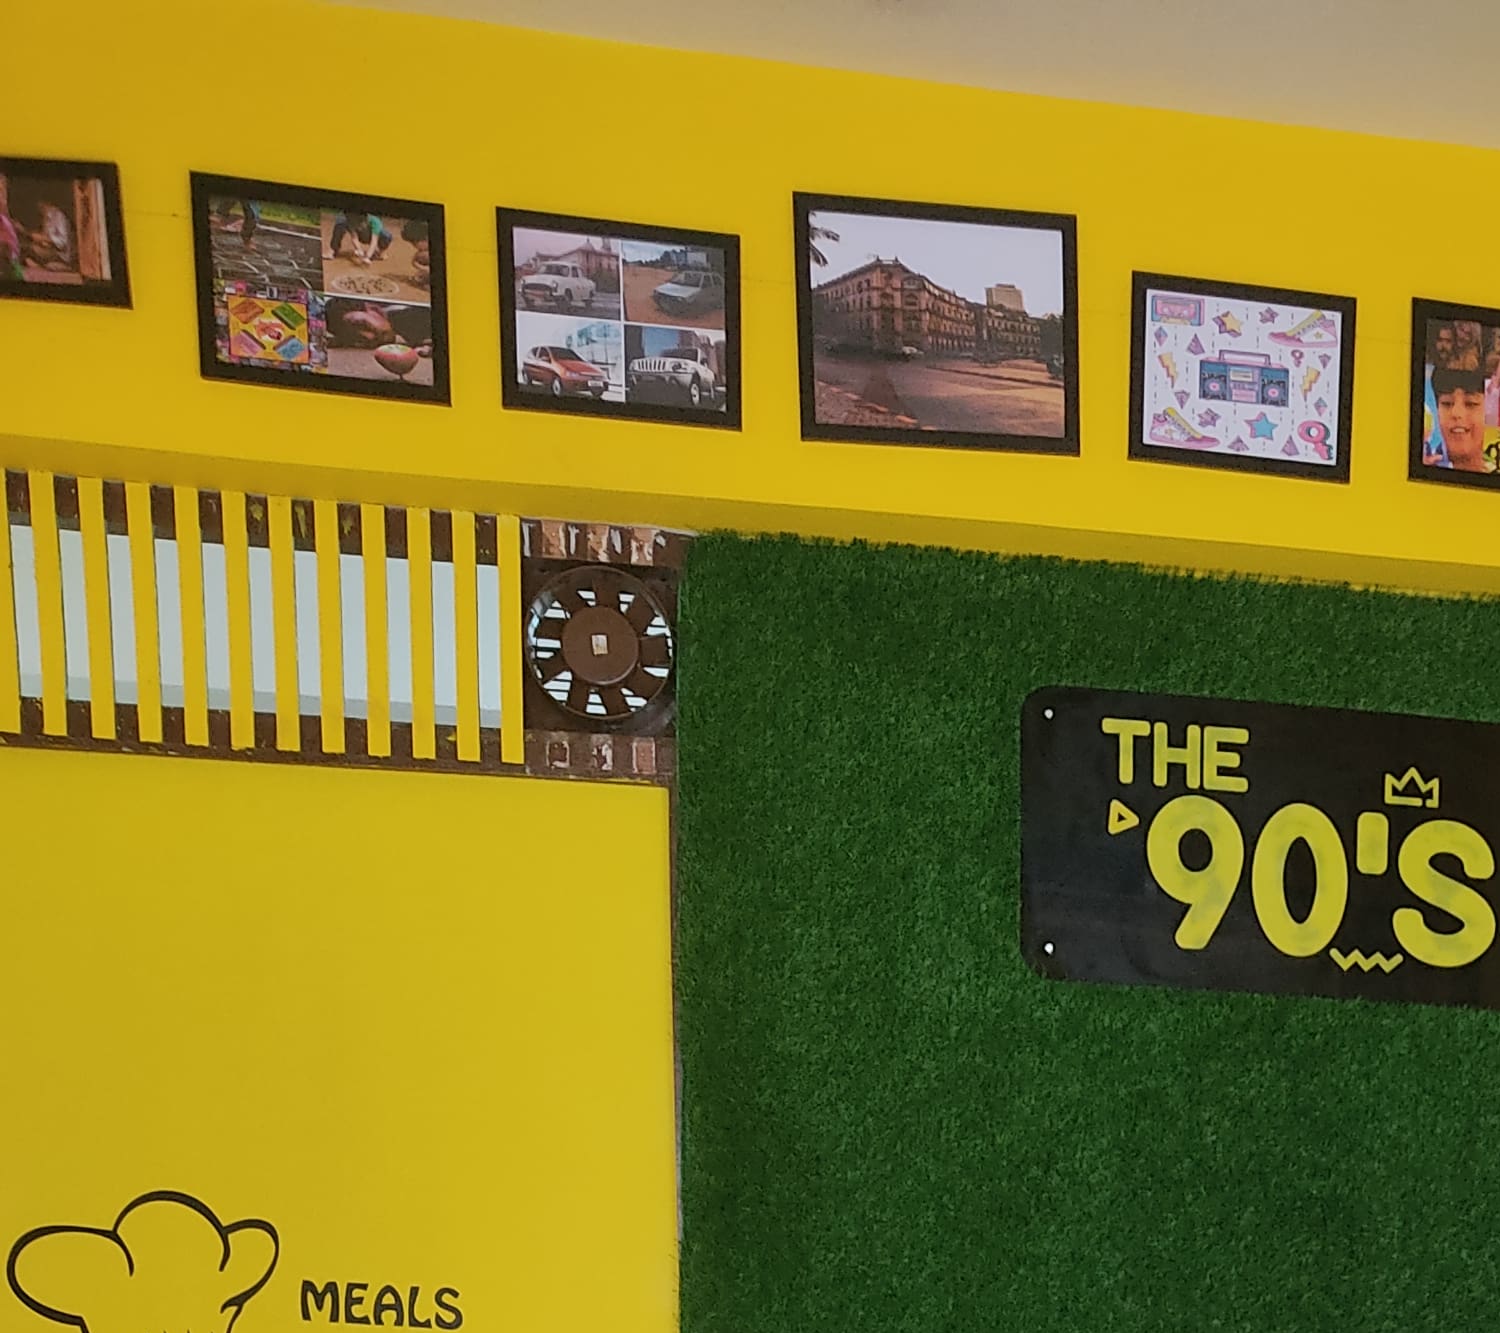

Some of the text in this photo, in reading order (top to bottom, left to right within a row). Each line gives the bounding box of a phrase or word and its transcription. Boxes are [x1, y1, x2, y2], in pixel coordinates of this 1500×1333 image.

[1102, 718, 1249, 792] THE
[1145, 793, 1498, 969] 90'S
[301, 1280, 462, 1330] MEALS
